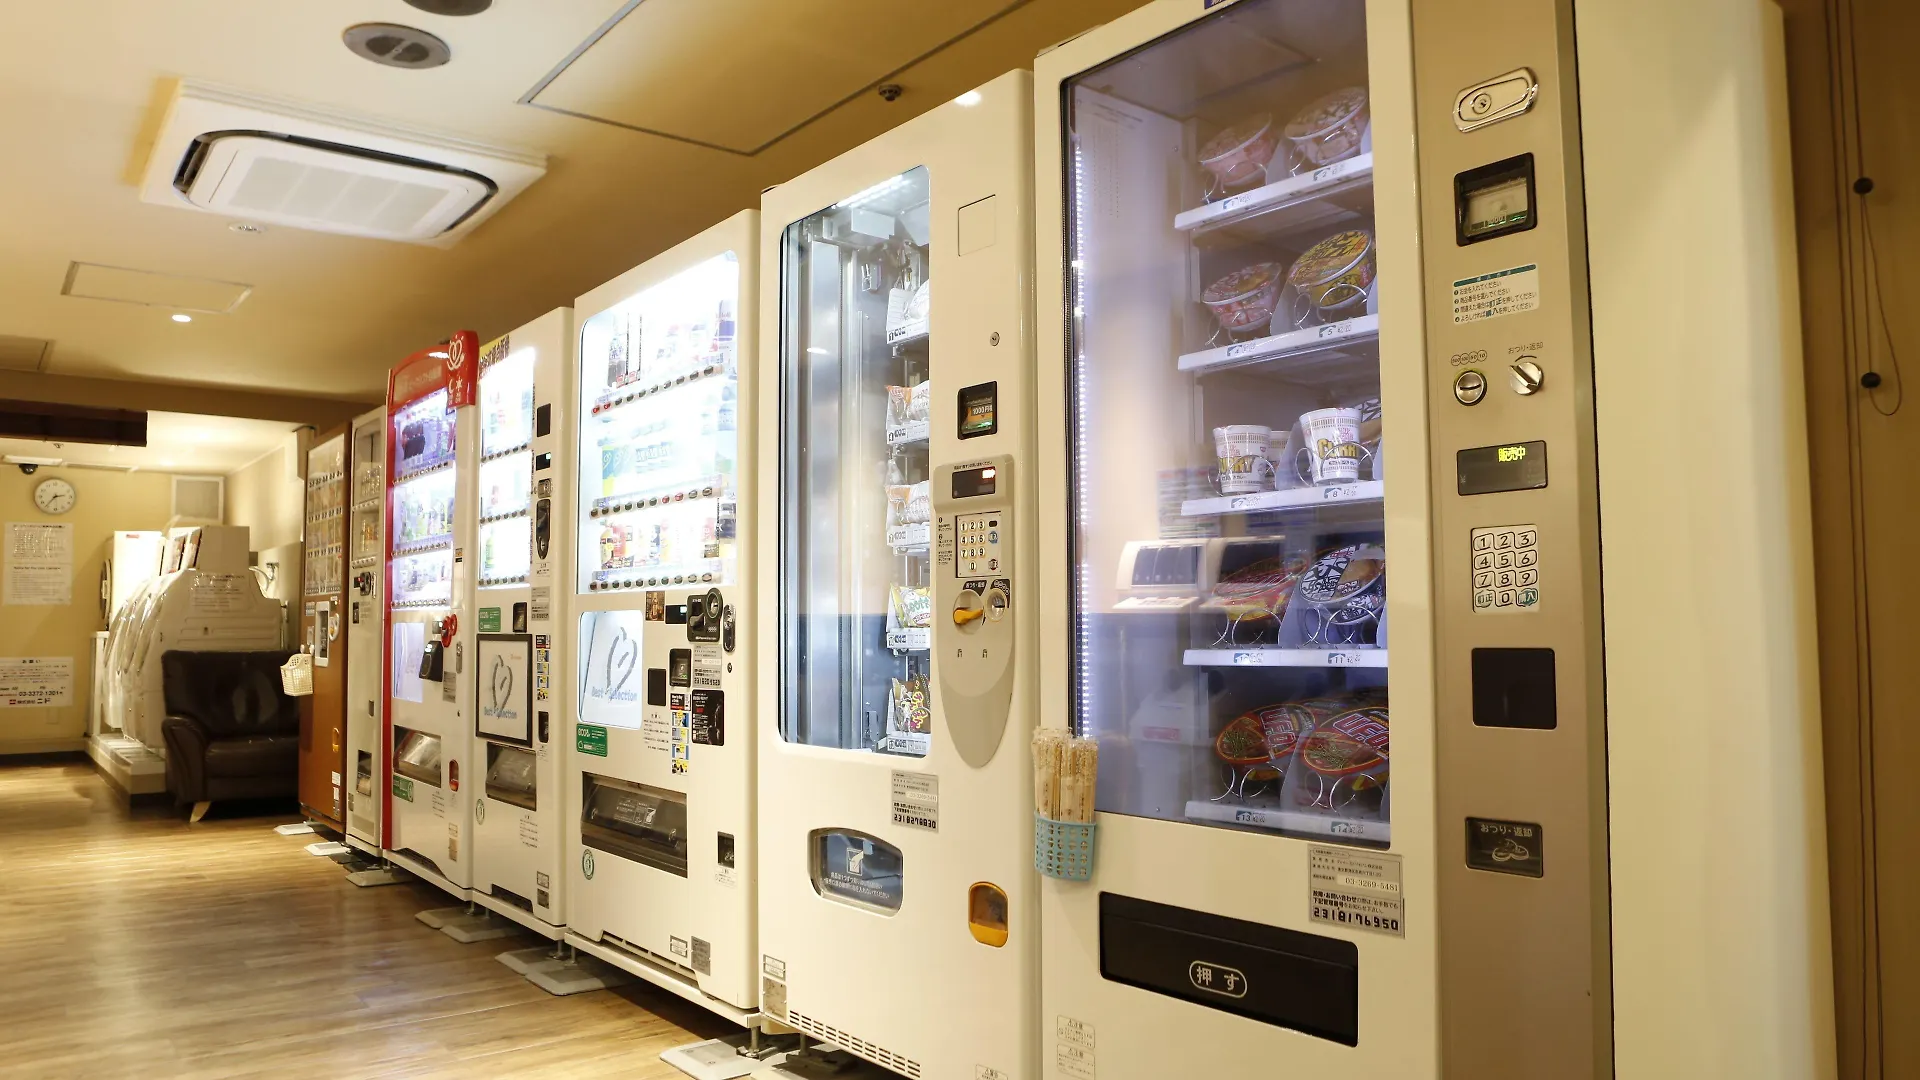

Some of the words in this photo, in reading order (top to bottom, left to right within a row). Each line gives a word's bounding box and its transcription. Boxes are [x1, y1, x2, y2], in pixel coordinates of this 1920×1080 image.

[1498, 446, 1526, 462] 販売中
[1480, 537, 1486, 547] 1
[1500, 535, 1508, 546] 2
[1521, 534, 1530, 545] 3
[1480, 556, 1488, 566] 4
[1500, 555, 1508, 565] 5
[1521, 553, 1530, 565] 6
[1480, 574, 1488, 585] 7
[1501, 573, 1509, 584] 8
[1522, 572, 1530, 583] 9
[1501, 592, 1510, 603] 0
[1480, 824, 1533, 837] おつり・返却
[1345, 877, 1398, 891] 03-3269-5481
[1196, 965, 1240, 991] 押す
